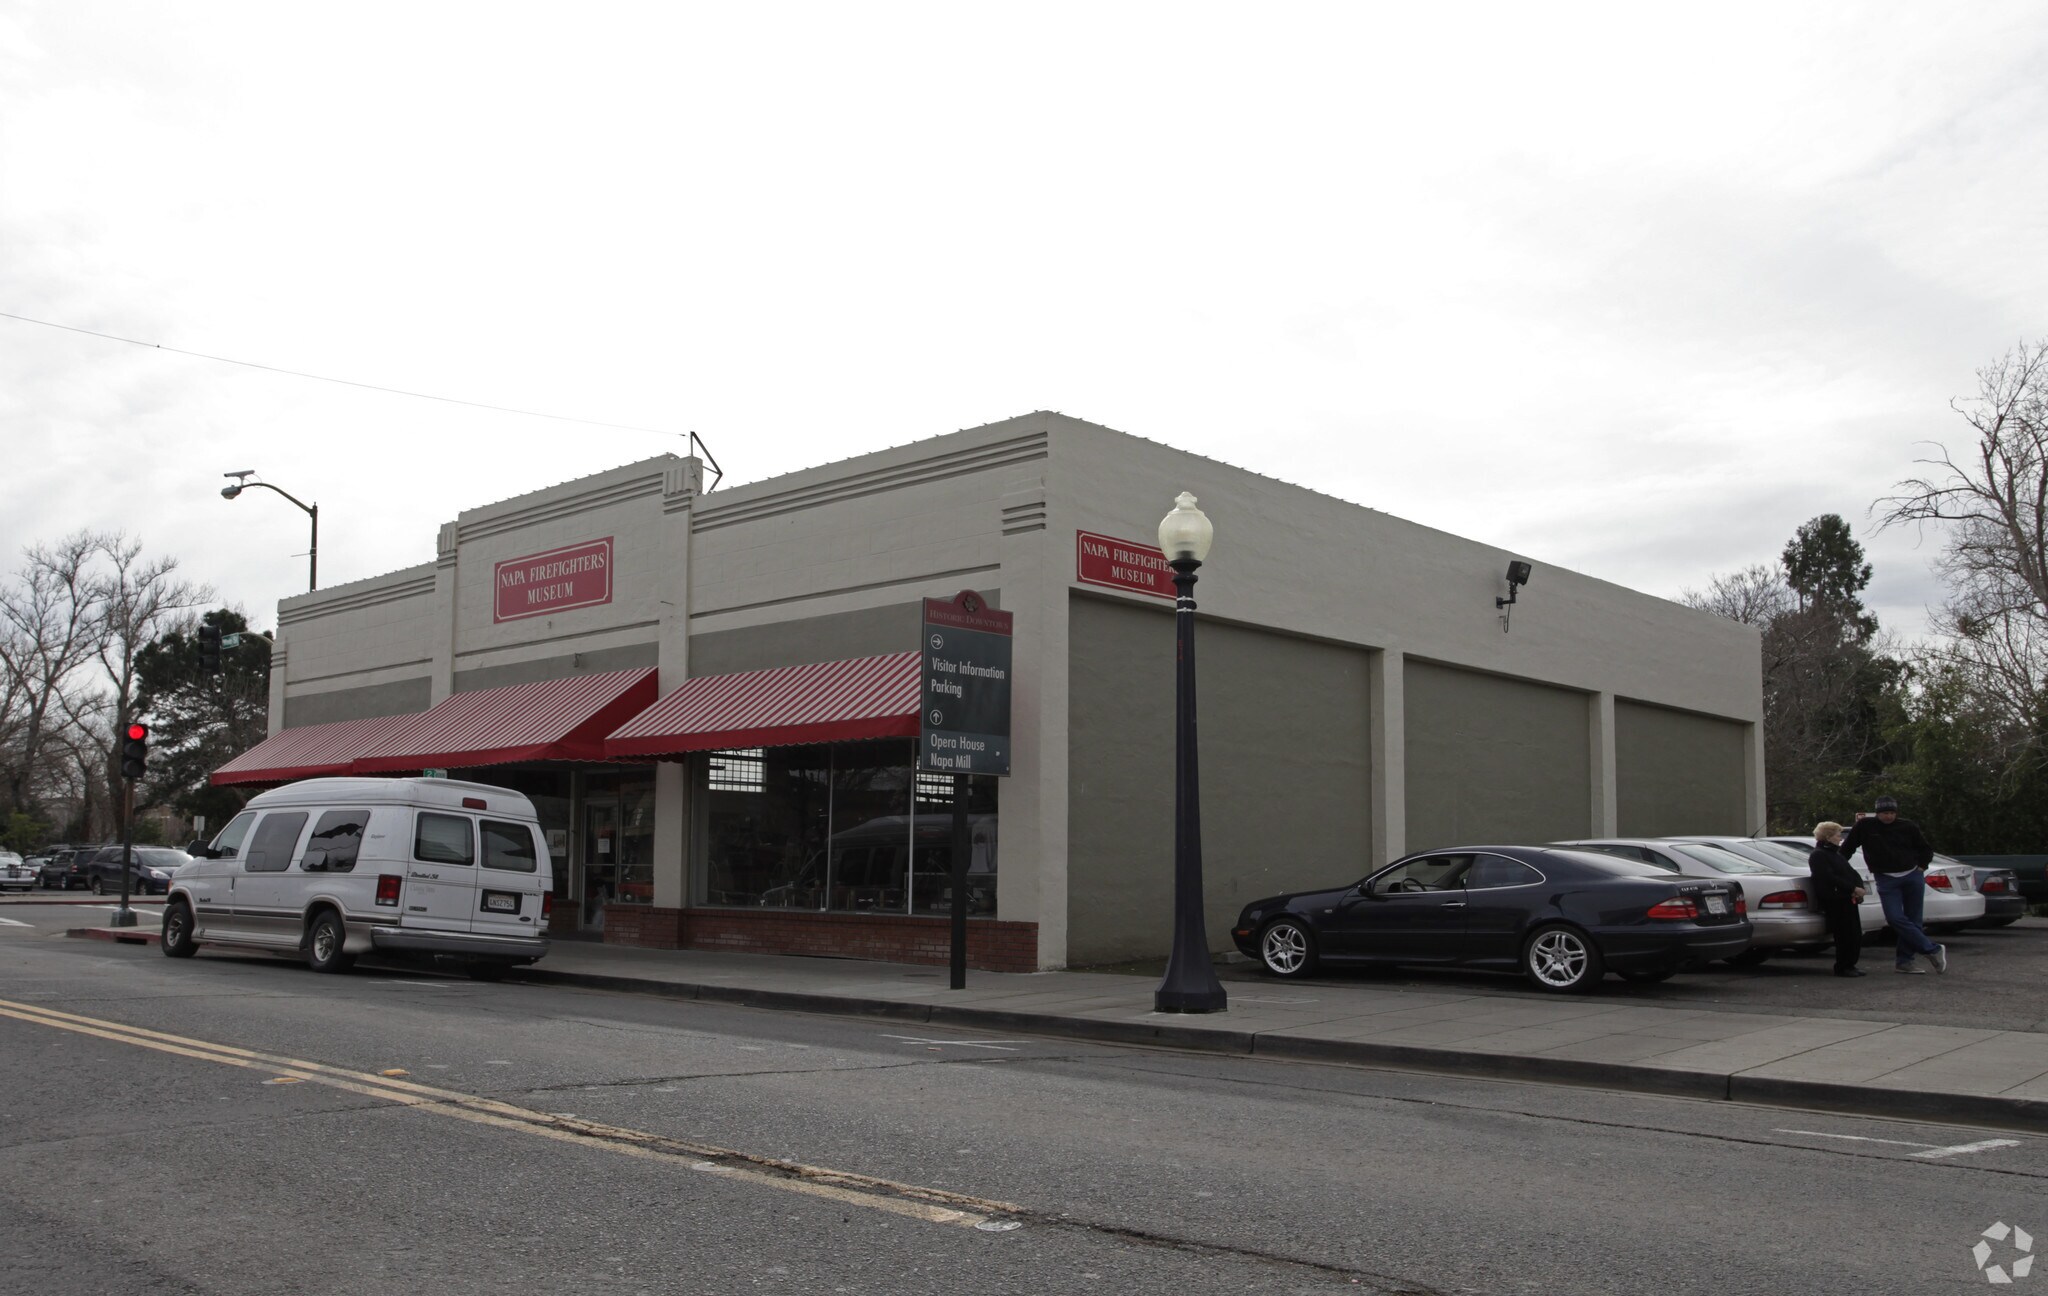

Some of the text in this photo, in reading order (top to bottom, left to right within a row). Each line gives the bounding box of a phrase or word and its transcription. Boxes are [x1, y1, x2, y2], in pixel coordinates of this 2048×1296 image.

[1084, 541, 1179, 574] NAPA FIREFIGHTER
[501, 552, 605, 588] NAPA FIREFIGHTERS
[1111, 565, 1155, 586] MUSEUM
[527, 581, 574, 605] MUSEUM
[932, 656, 1005, 680] Visitor Information
[931, 678, 962, 699] Parking
[930, 733, 985, 752] Opera House
[930, 752, 972, 770] Napa Mill
